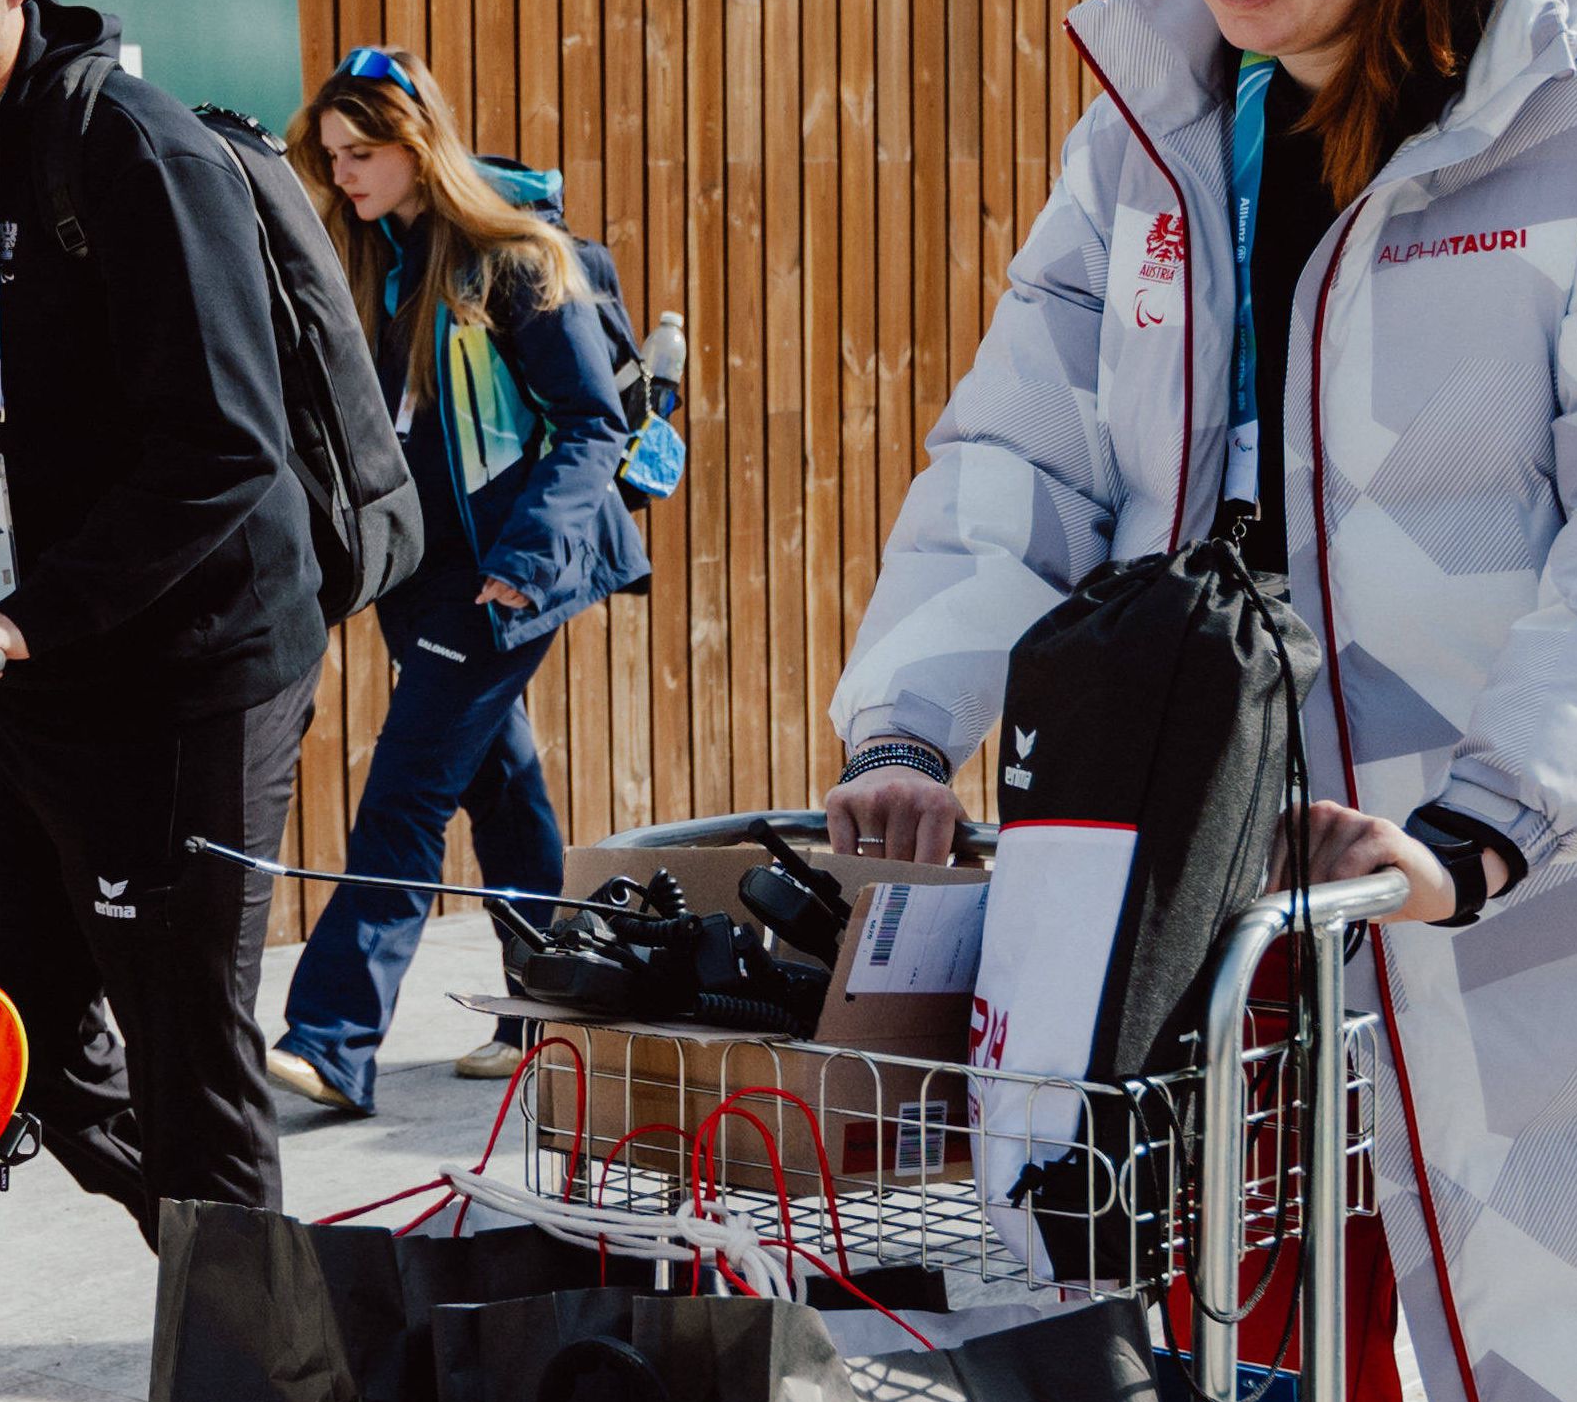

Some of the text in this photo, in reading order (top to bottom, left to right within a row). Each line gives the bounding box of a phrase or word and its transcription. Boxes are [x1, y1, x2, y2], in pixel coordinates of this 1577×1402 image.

[1238, 197, 1250, 243] Allianz
[1378, 229, 1527, 264] ALPHATAURI
[1139, 263, 1176, 281] AUSTRIA
[94, 901, 136, 919] erima
